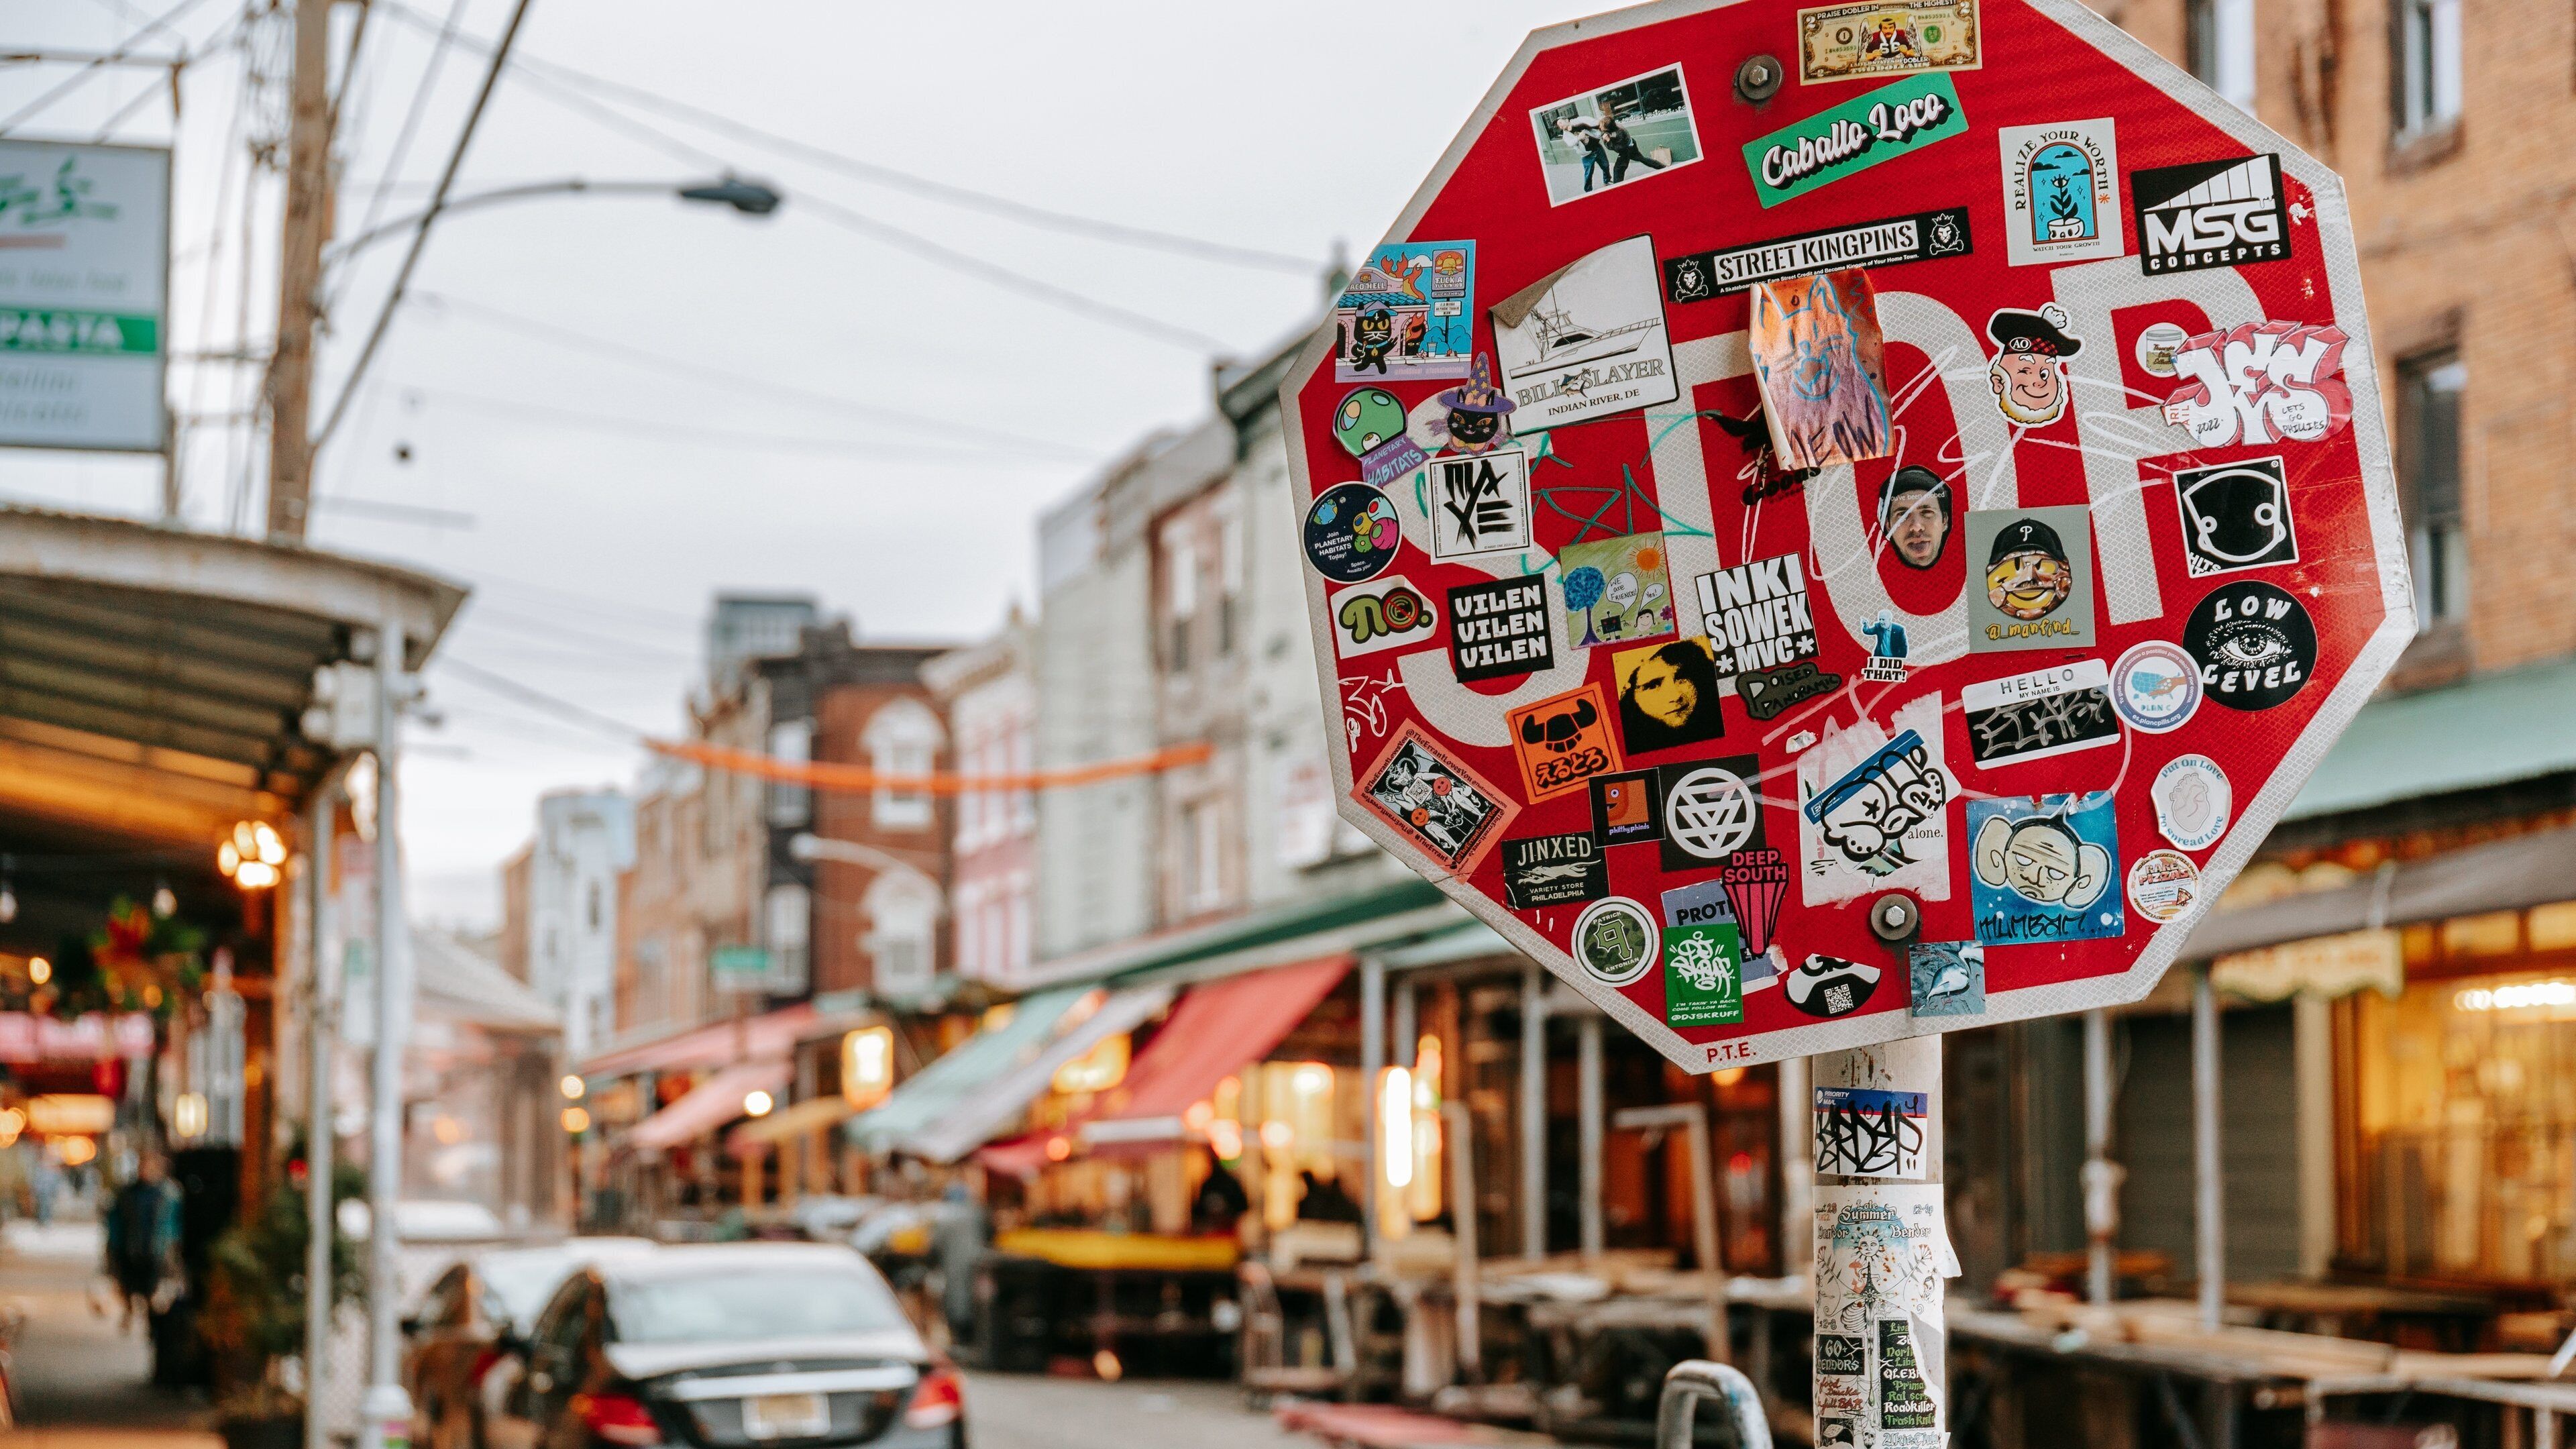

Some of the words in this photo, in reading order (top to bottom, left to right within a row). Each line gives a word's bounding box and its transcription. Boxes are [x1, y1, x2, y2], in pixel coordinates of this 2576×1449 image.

[1817, 10, 1841, 19] PRAISE
[1842, 5, 1870, 15] DOBLER
[1904, 56, 1929, 64] DOBLER
[1761, 119, 1868, 186] Caballo
[1868, 93, 1945, 141] Loco
[2014, 138, 2038, 211] REALIZE
[2039, 130, 2080, 144] YOUR
[2084, 136, 2110, 191] WORTH
[2145, 199, 2281, 257] MSG
[1719, 244, 1798, 282] STREET
[1802, 225, 1915, 266] KINGPINS
[2150, 244, 2282, 271] CONCEPTS
[1780, 274, 1796, 282] Street
[1796, 270, 1813, 278] Credit
[1825, 266, 1845, 274] Become
[1846, 262, 1867, 270] Kingpin
[1874, 257, 1886, 265] Your
[2012, 339, 2029, 349] AO
[1516, 379, 1568, 408] BILL
[1581, 358, 1665, 390] SLAYER
[1548, 400, 1587, 416] INDIAN
[1590, 392, 1623, 407] RIVER,
[1625, 389, 1640, 398] DE
[2282, 402, 2305, 414] LETS
[2289, 413, 2302, 422] GO
[2283, 419, 2325, 434] PHILLIES
[1363, 437, 1406, 467] PLANETARY
[1366, 449, 1423, 486] HABITATS
[1315, 534, 1353, 549] PLANETARY
[1319, 543, 1352, 555] HABITATS
[1328, 551, 1347, 561] Today!
[1610, 577, 1622, 587] WE
[1695, 553, 1805, 614] INKI
[1455, 585, 1542, 618] VILEN
[1611, 588, 1637, 600] FRIENDS!
[1646, 589, 1658, 598] Yes!
[2214, 595, 2292, 623] LOW
[1457, 610, 1544, 643] VILEN
[1705, 592, 1813, 652] SOWEK
[1460, 635, 1547, 669] VILEN
[2167, 651, 2180, 660] para
[1868, 658, 1874, 668] I
[1878, 657, 1902, 669] DID
[1864, 669, 1907, 682] THAT!
[2000, 668, 2074, 694] HELLO
[2201, 661, 2301, 692] LEVEL
[2032, 688, 2050, 697] NAME
[2132, 713, 2182, 727] es.plancpills.org
[1405, 727, 1475, 783] @TheErrantLovesYou
[1363, 735, 1409, 794] @TheErrantLovesYou
[1536, 747, 1609, 790] えるとろ
[2161, 761, 2180, 778] Put
[2182, 759, 2197, 767] On
[2200, 760, 2224, 780] Love
[1359, 792, 1415, 837] @TheErrantLovesYou
[1909, 827, 1943, 839] alone.
[2159, 813, 2167, 828] To
[2206, 816, 2224, 839] Love
[1413, 834, 1449, 863] #TheErrant
[1517, 837, 1592, 867] JINXED
[1732, 849, 1778, 866] DEEP
[1725, 866, 1786, 883] SOUTH
[2139, 868, 2190, 885] PIZZAS
[2145, 863, 2179, 874] RARE
[1529, 885, 1558, 894] VARIETY
[1562, 881, 1584, 891] STORE
[1532, 889, 1585, 902] PHILADELPHIA
[1593, 910, 1622, 925] PATRICK
[1605, 957, 1640, 973] ANTONIAN
[1671, 1010, 1739, 1021] @DJSKRUFF
[1707, 1042, 1756, 1063] P.T.E.
[1856, 1199, 1878, 1210] Late
[1839, 1203, 1898, 1225] Summer
[1888, 1223, 1931, 1238] Bender
[1825, 1339, 1847, 1357] 60+
[1887, 1390, 1907, 1401] Rat
[1883, 1400, 1935, 1413] Roadkiller
[1885, 1414, 1915, 1426] Trash
